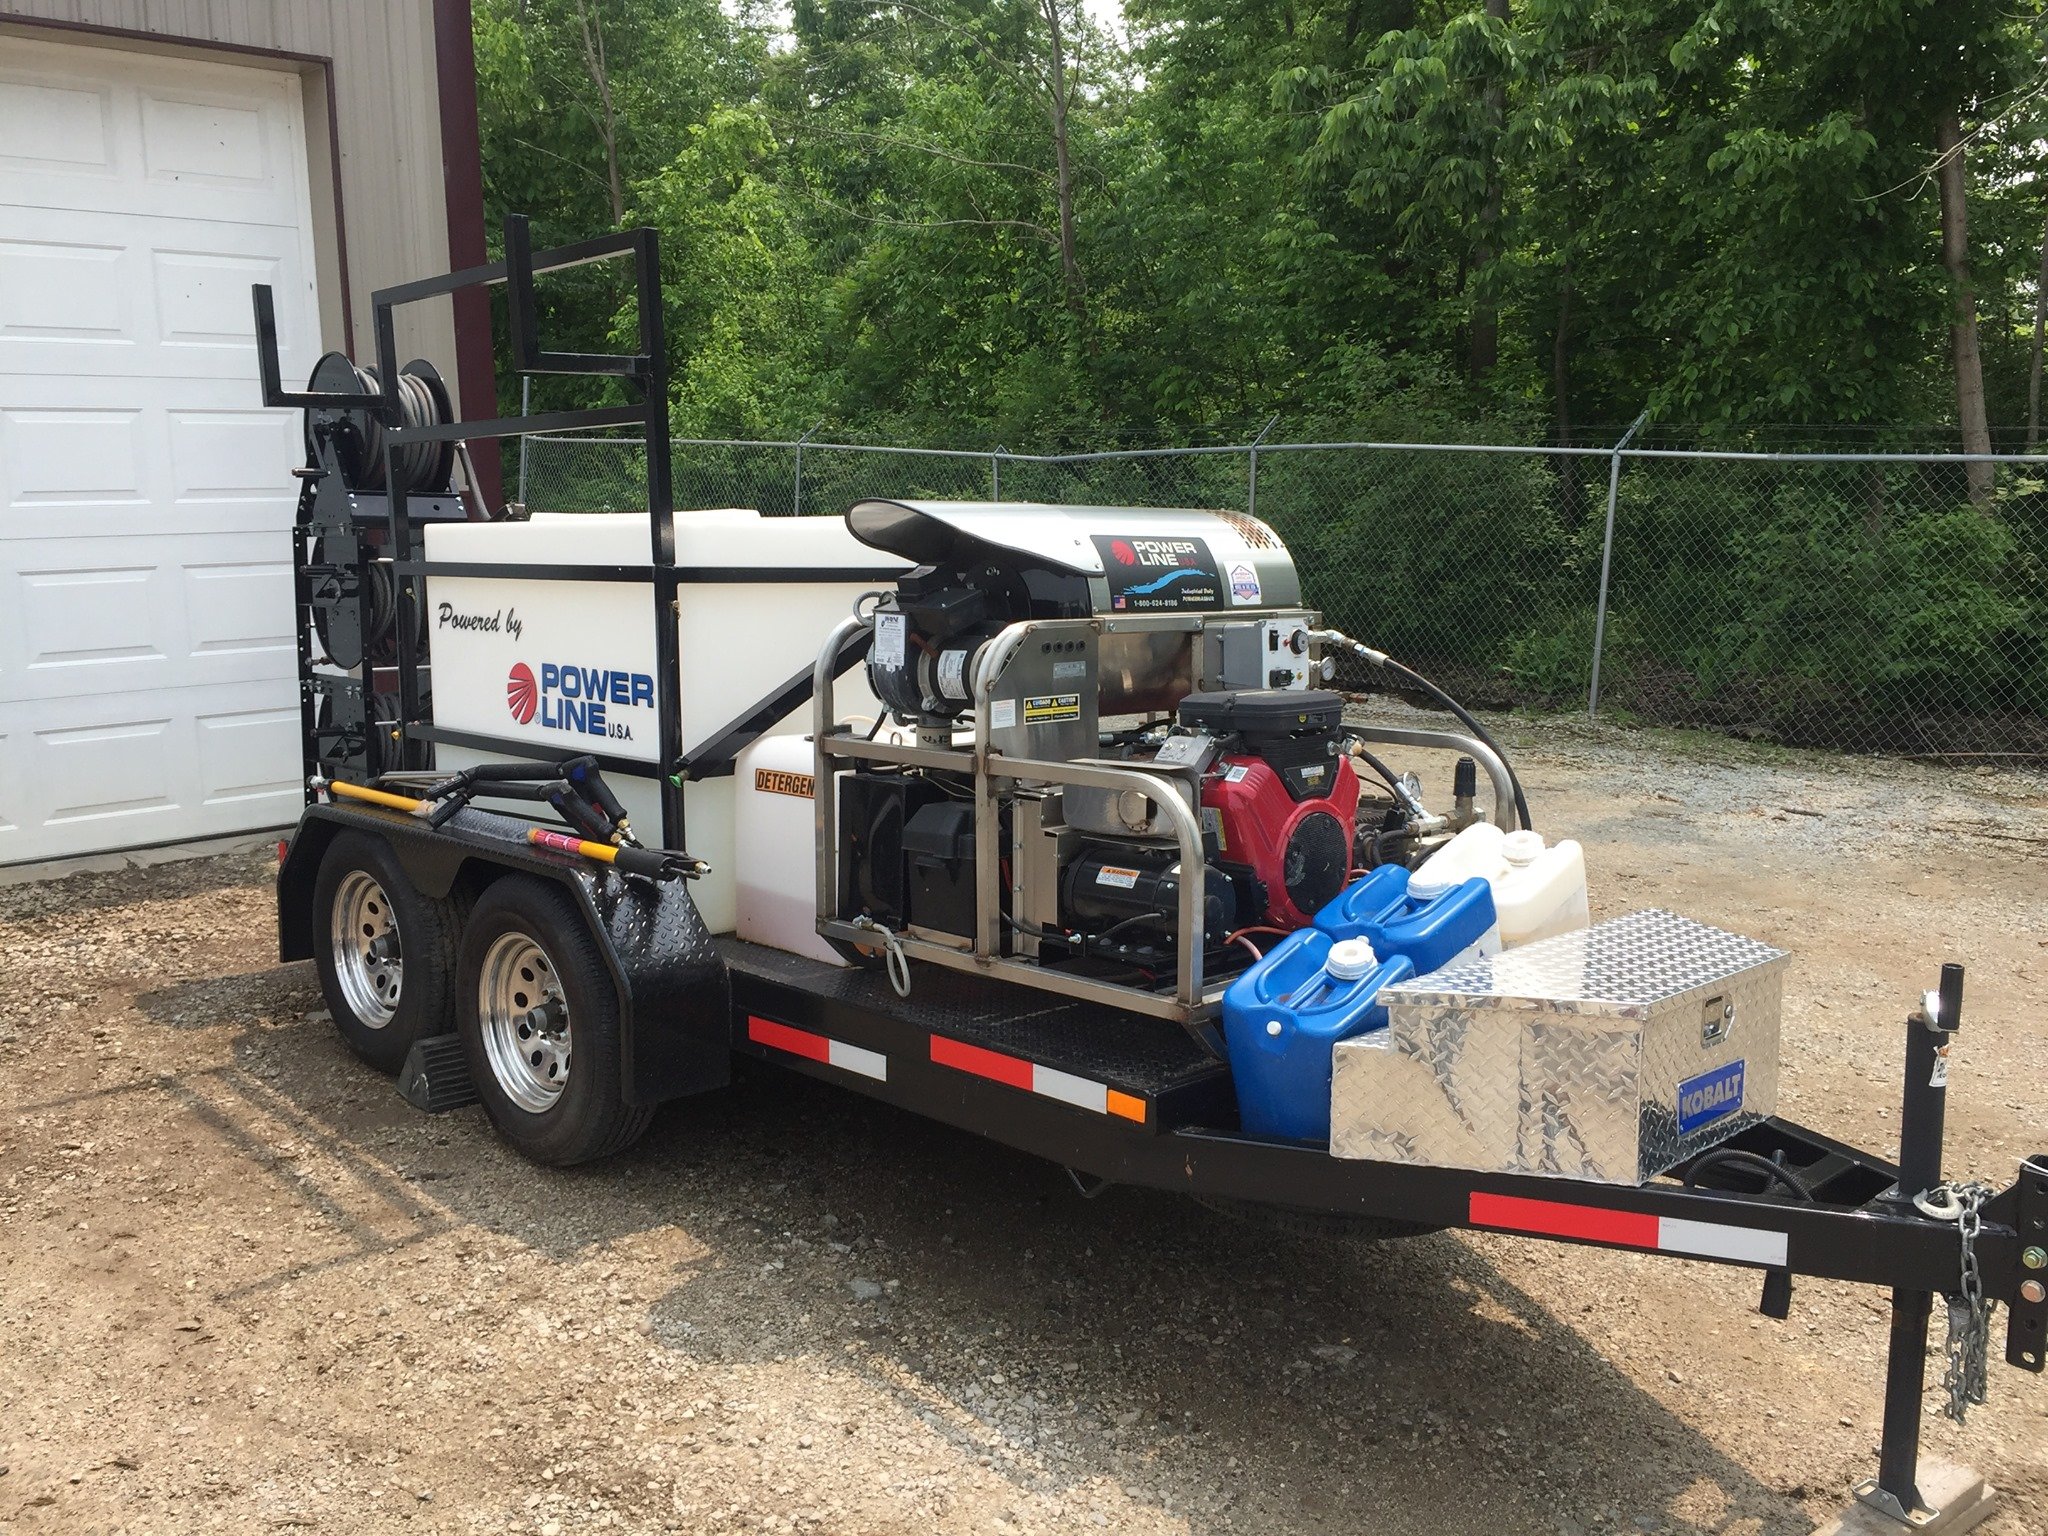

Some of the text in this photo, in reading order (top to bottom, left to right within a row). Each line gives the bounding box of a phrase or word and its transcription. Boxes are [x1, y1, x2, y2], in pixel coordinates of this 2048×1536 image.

[1131, 541, 1197, 553] POWER
[1138, 553, 1179, 565] LINE
[438, 602, 523, 641] Powered by
[541, 663, 654, 708] POWER
[541, 696, 634, 741] LINE U.S.A.
[757, 771, 815, 796] DETERGEN
[1682, 1074, 1741, 1120] KOBALT
